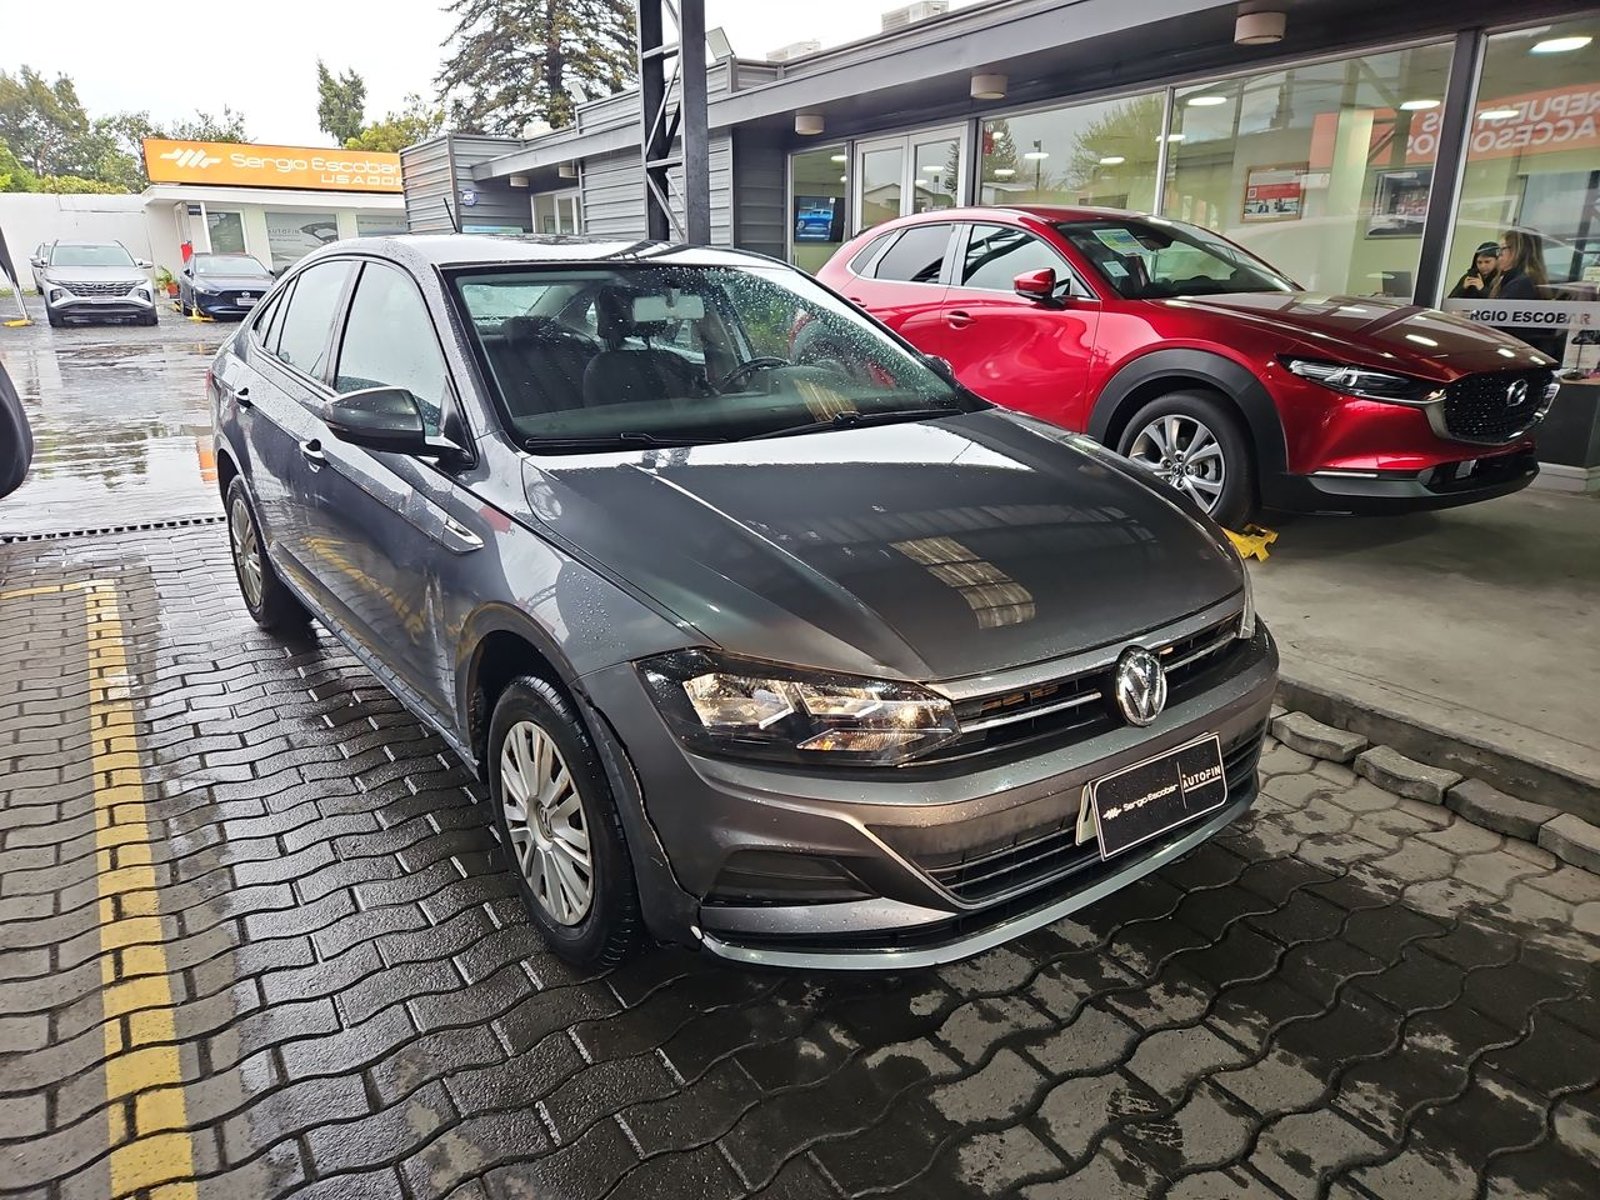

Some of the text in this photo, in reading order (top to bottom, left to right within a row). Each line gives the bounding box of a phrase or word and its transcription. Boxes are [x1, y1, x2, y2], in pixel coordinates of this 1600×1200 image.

[230, 153, 400, 175] Sergio Escobar
[1183, 765, 1222, 789] AUTOFIN
